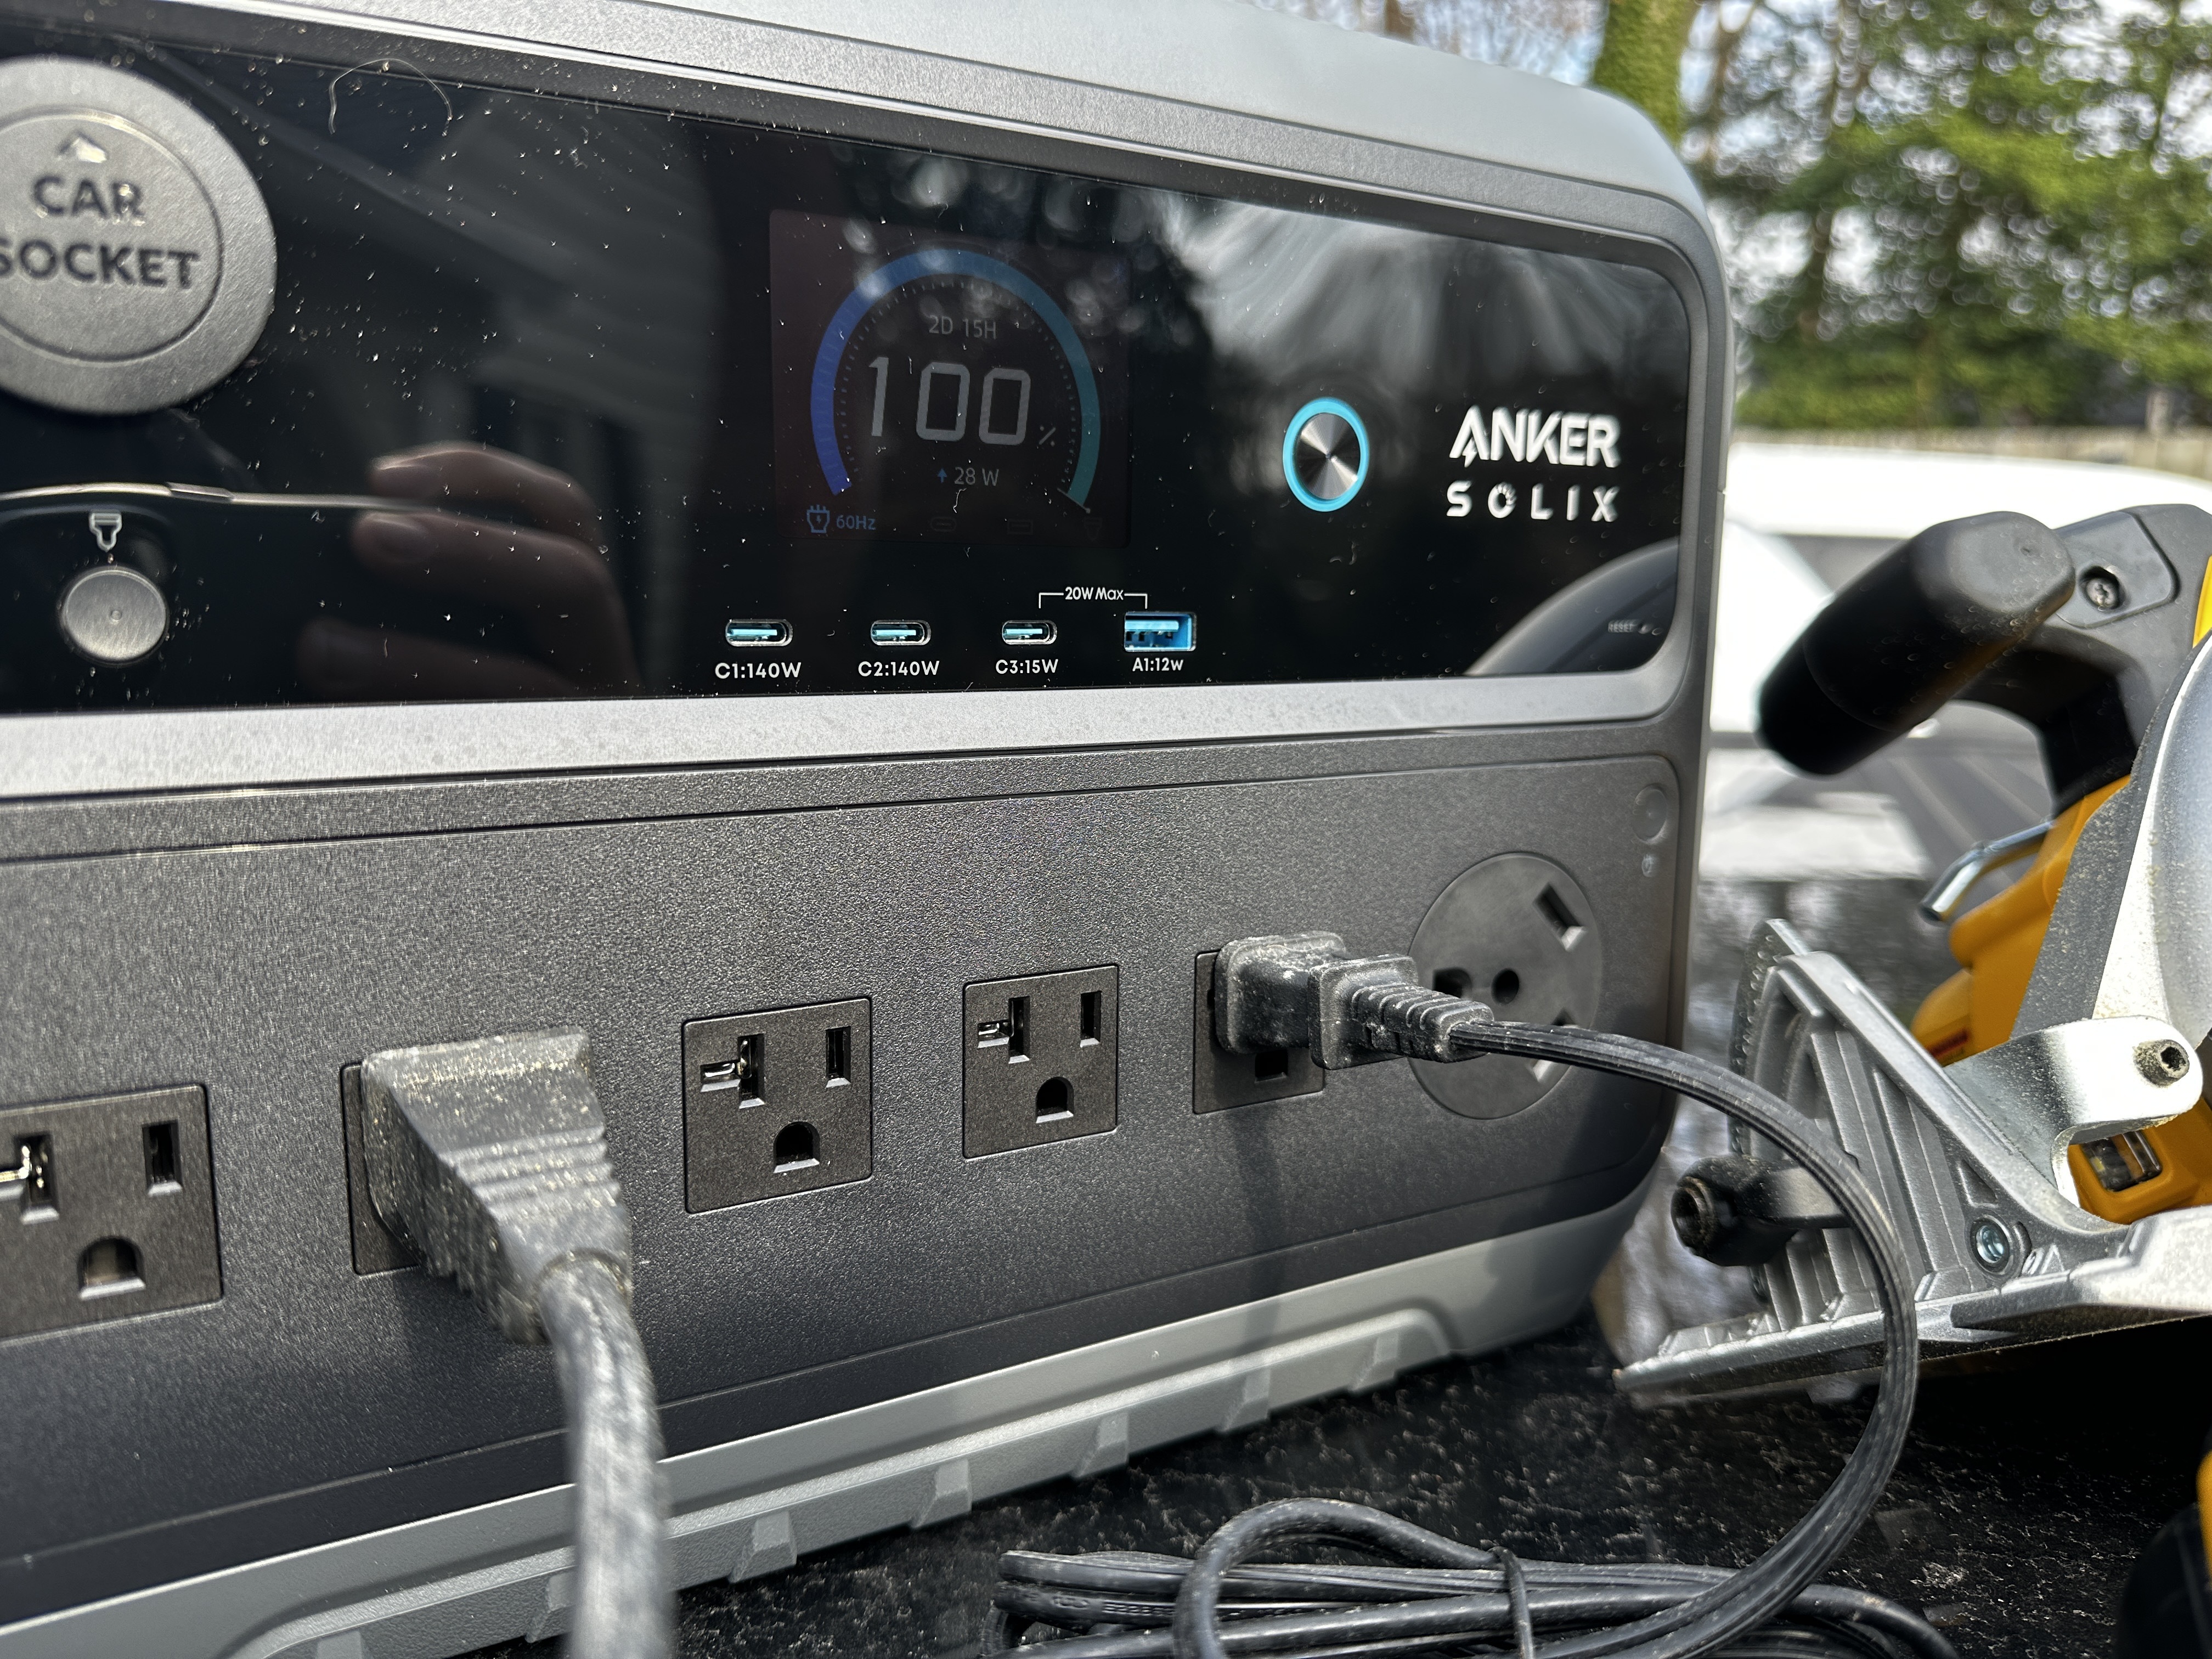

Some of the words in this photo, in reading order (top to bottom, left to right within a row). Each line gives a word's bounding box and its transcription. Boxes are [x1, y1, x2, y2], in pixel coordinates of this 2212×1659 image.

[32, 173, 145, 217] CAR
[928, 315, 953, 334] 2D
[963, 318, 998, 340] 15H
[1449, 405, 1621, 467] ANKER
[954, 466, 975, 485] 28
[981, 469, 1000, 486] W
[1446, 480, 1620, 522] SOLIX
[836, 514, 876, 531] 60Hz
[1065, 586, 1093, 600] 20W
[1095, 588, 1124, 600] Max
[714, 662, 802, 679] C1:140W
[858, 661, 940, 676] C2:140W
[995, 659, 1058, 674] C3:15W
